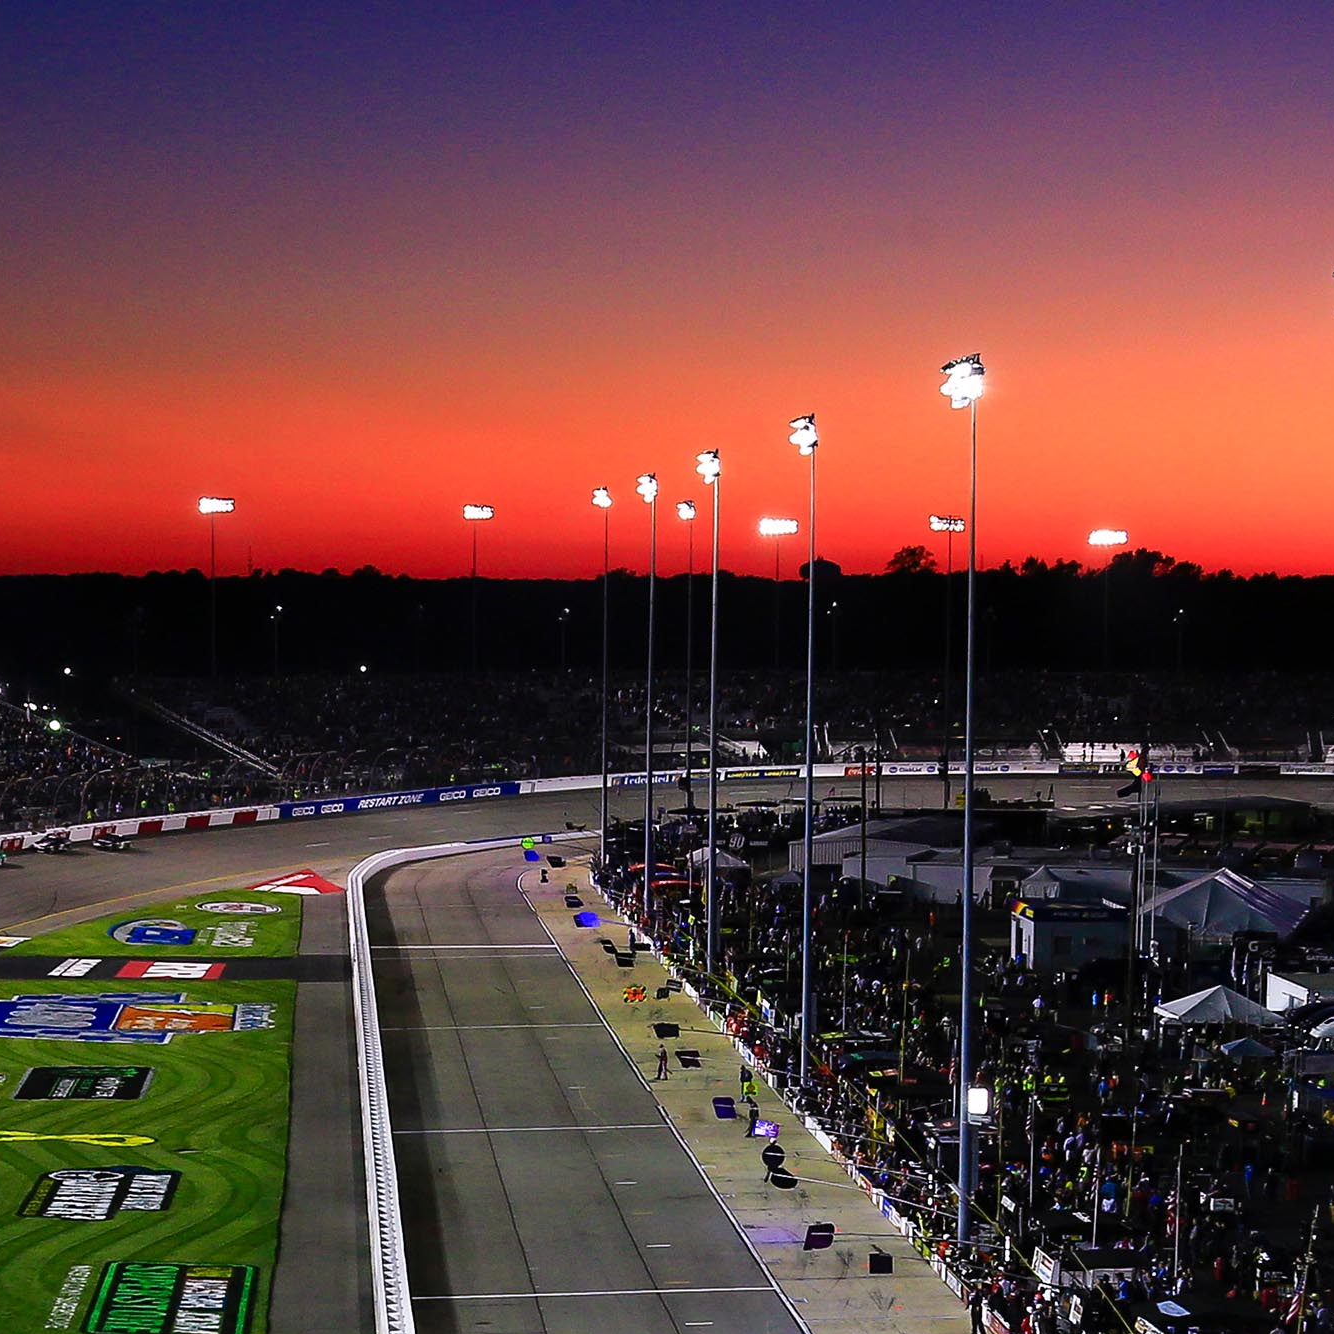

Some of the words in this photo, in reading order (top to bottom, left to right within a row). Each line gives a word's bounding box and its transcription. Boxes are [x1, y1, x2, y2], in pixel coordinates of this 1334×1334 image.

[624, 774, 675, 785] Fedeated
[440, 790, 466, 801] GEICO
[473, 787, 501, 798] GEICO
[358, 796, 397, 809] RESTART
[397, 793, 424, 805] ZONE
[292, 806, 315, 816] GEICO
[321, 803, 344, 814] GEICO
